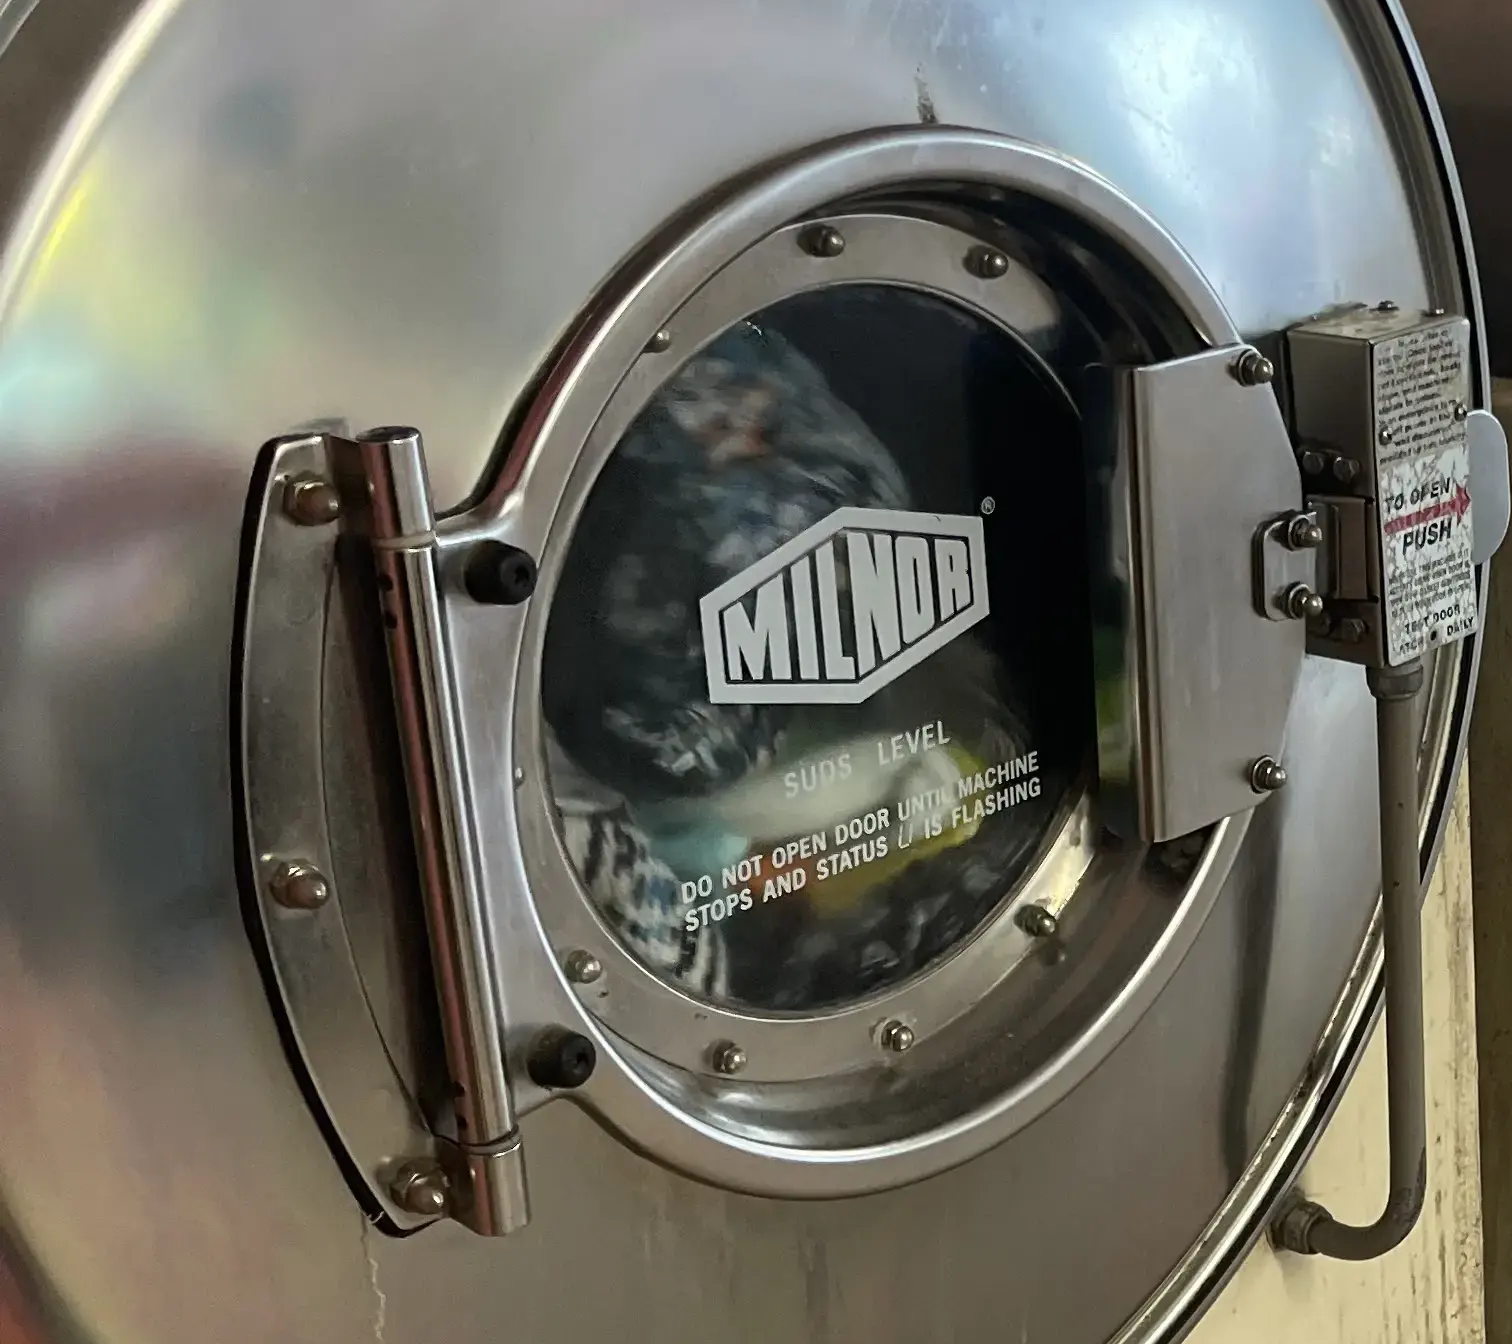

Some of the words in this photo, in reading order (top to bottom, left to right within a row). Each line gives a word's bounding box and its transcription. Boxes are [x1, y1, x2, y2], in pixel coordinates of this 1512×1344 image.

[1384, 492, 1405, 514] TO
[1410, 477, 1451, 504] OPEN
[1403, 516, 1453, 556] PUSH
[722, 531, 975, 683] MILNOR
[1432, 603, 1461, 623] DOOR
[1446, 616, 1474, 637] DAILY
[783, 753, 852, 800] SUDS
[877, 720, 951, 766] LEVEL
[681, 874, 713, 904] DO
[721, 855, 763, 890] NOT
[771, 830, 827, 869] OPEN
[835, 807, 890, 846] DOOR
[897, 791, 952, 822] UNTIL
[957, 750, 1040, 798] MACHINE
[685, 888, 754, 932] STOPS
[762, 868, 807, 904] AND
[816, 836, 888, 882] STATUS
[924, 813, 943, 839] IS
[951, 776, 1042, 830] FLASHING
